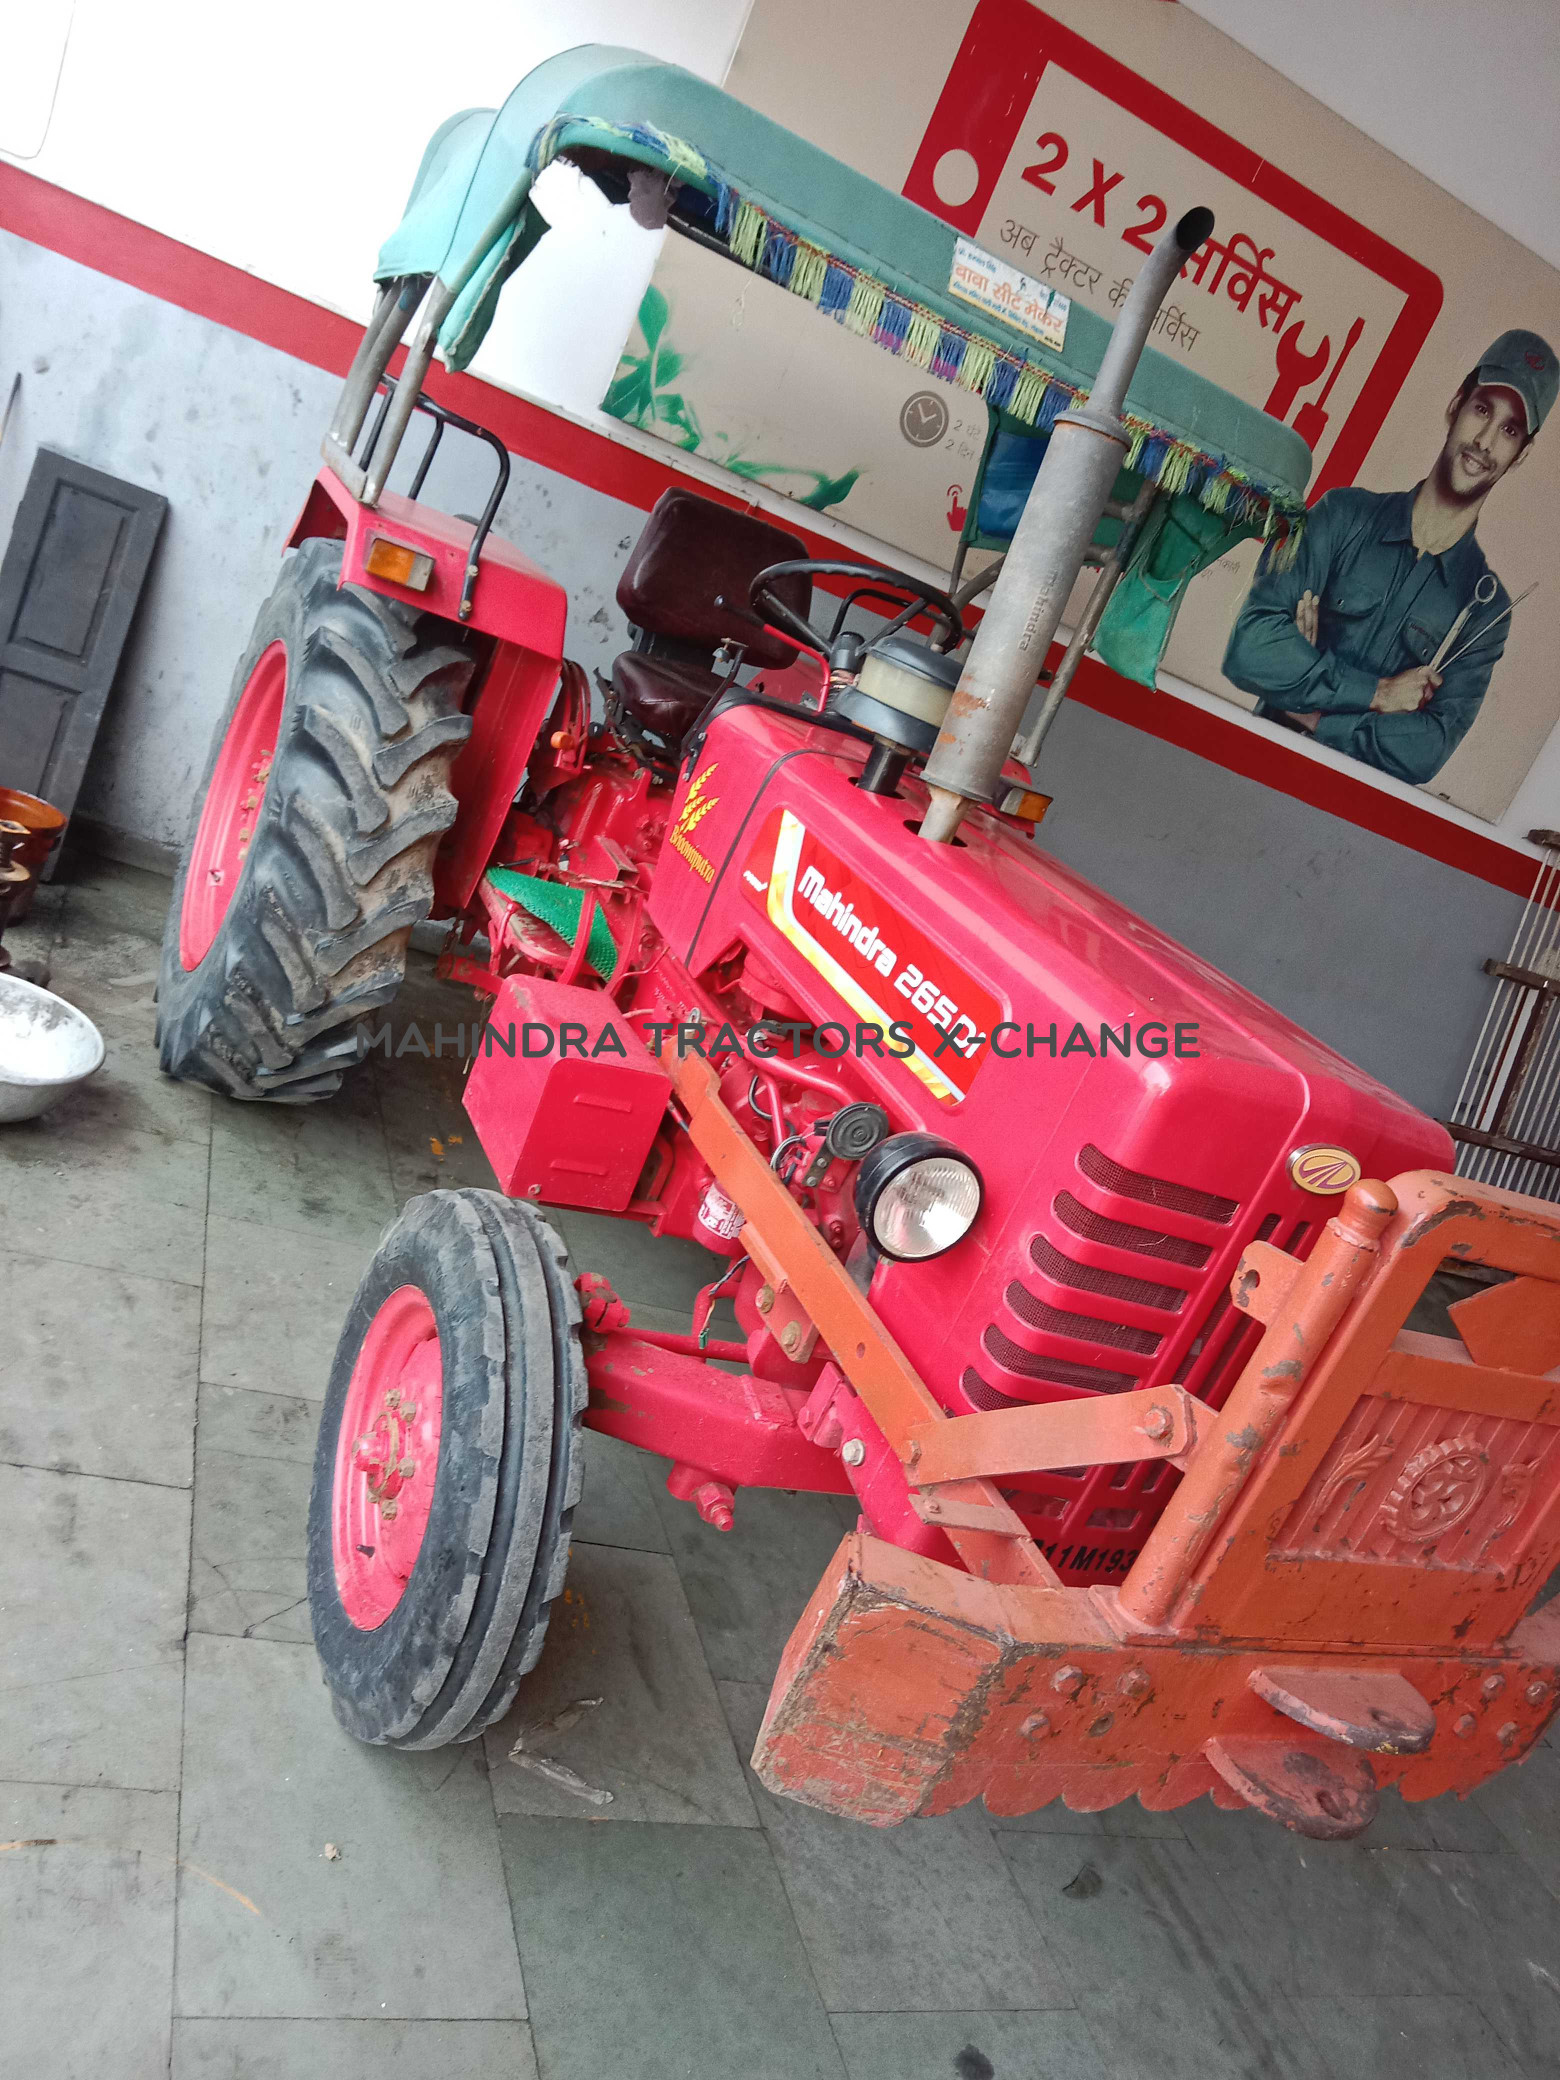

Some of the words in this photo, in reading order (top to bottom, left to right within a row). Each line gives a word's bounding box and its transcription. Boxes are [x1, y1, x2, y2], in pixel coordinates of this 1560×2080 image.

[1000, 219, 1040, 258] अब
[1040, 237, 1103, 295] ट्रैक्टर
[1020, 131, 1069, 197] 2
[1069, 157, 1125, 229] X
[1120, 193, 1168, 256] 2
[1180, 232, 1303, 335] सर्विस
[797, 865, 898, 978] Mahindra
